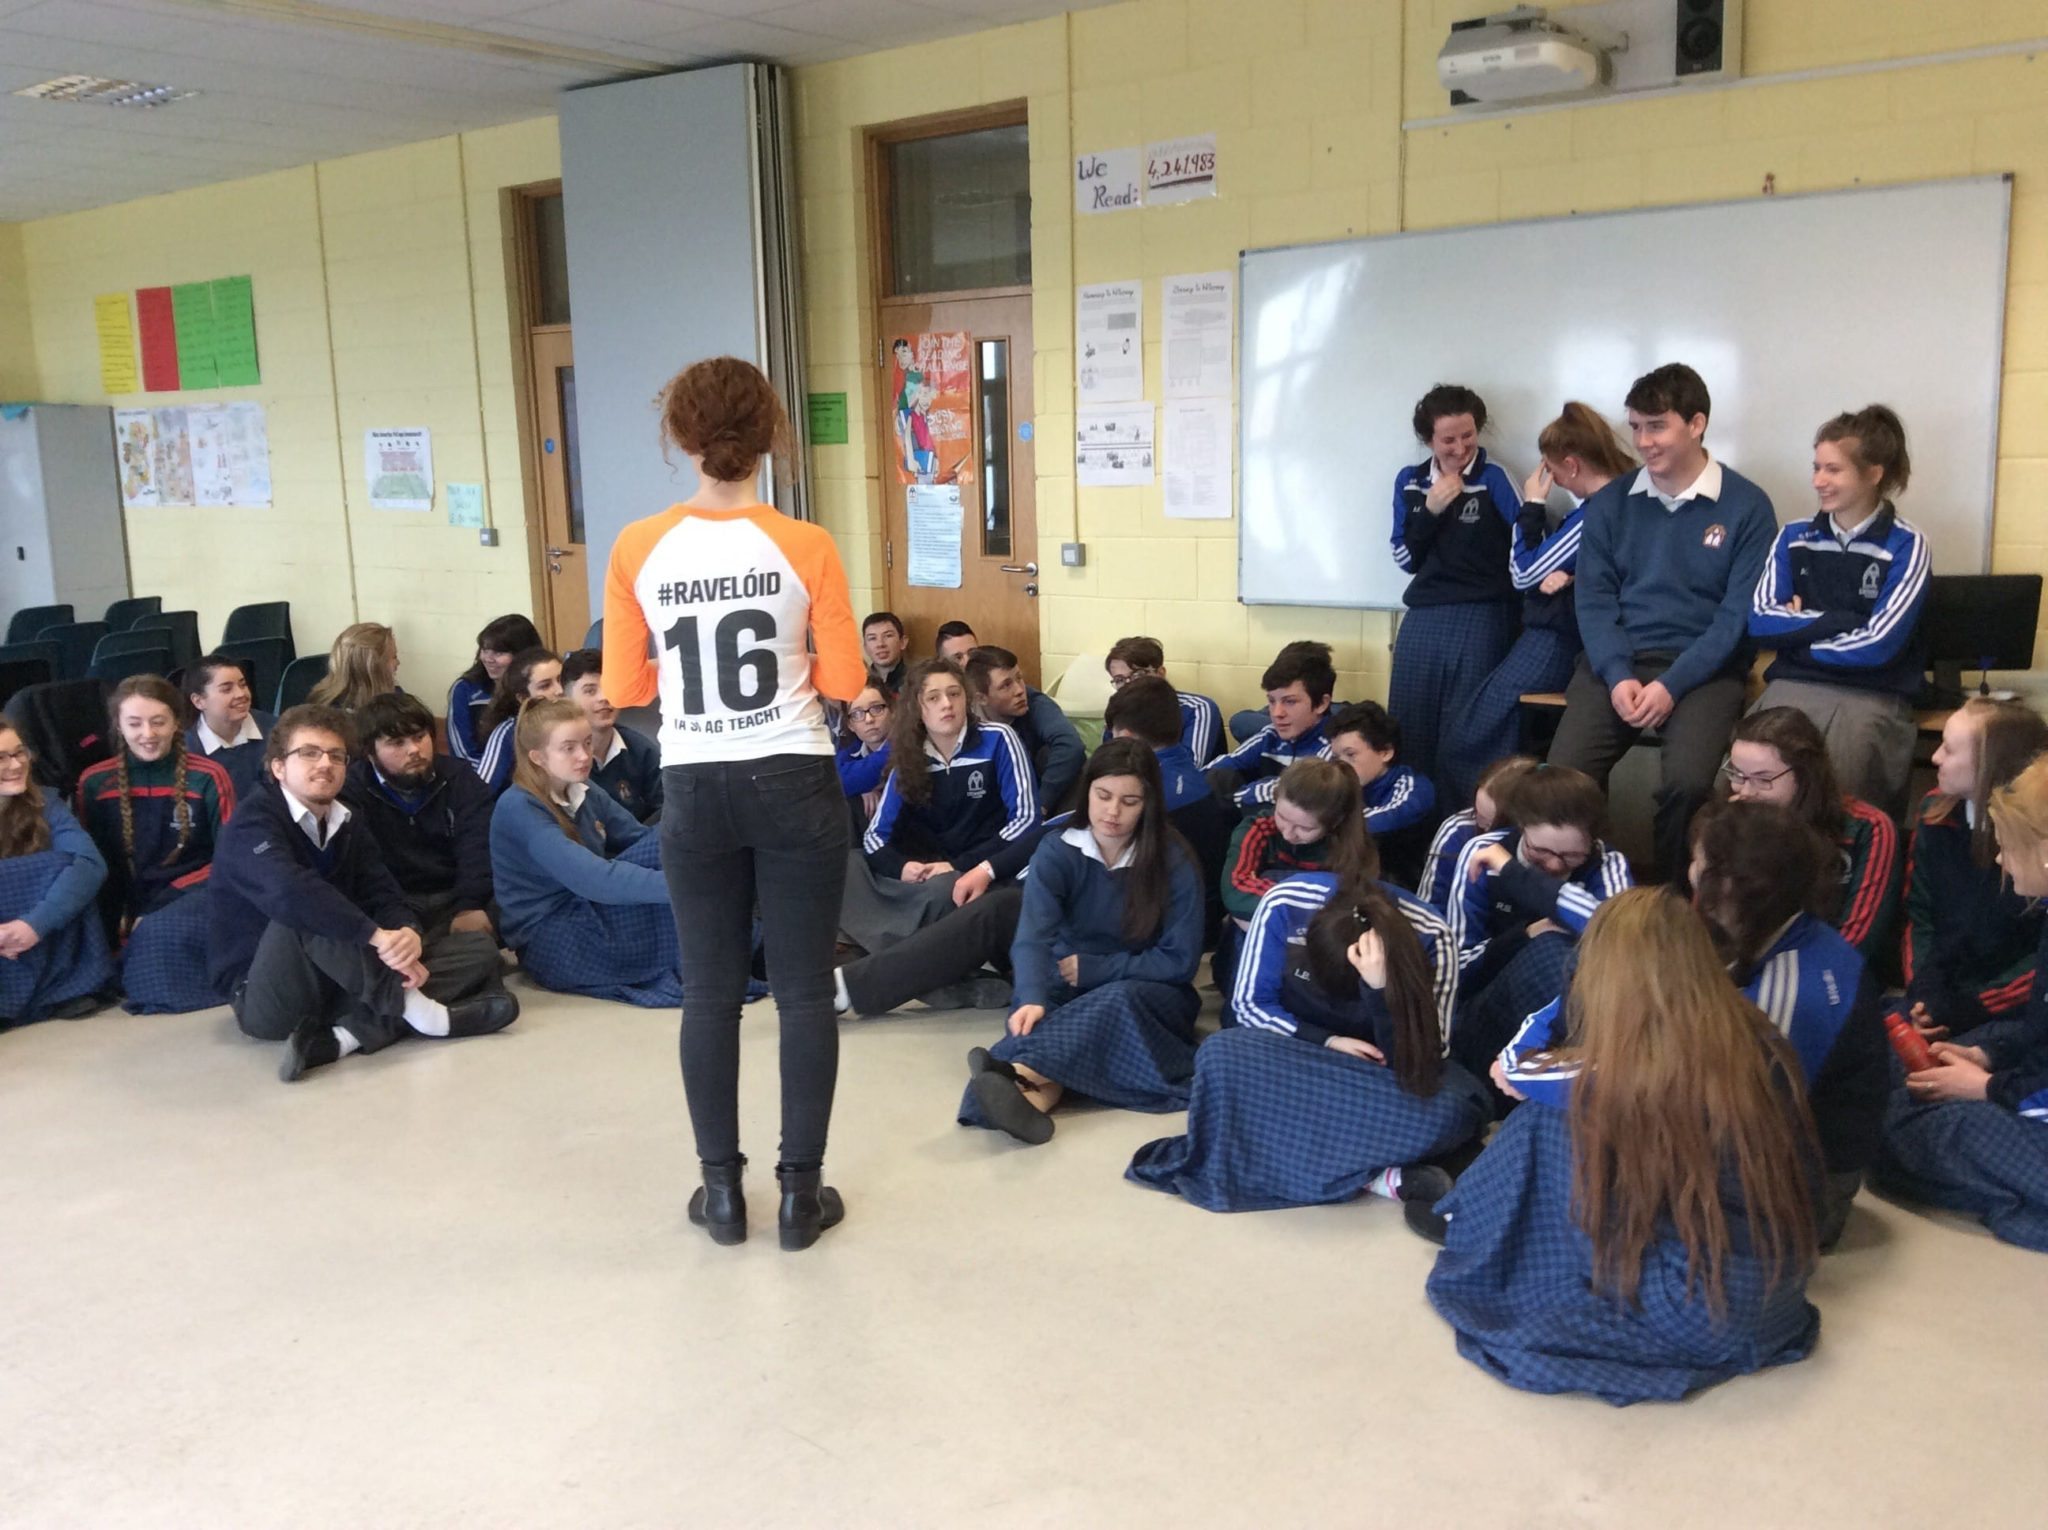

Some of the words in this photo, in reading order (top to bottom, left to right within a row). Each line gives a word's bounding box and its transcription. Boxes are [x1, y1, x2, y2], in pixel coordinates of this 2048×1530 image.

[1078, 157, 1108, 180] We
[658, 567, 781, 606] #RAVELÓID
[663, 609, 779, 715] 16
[705, 720, 724, 734] AG
[728, 705, 782, 731] TEACHT
